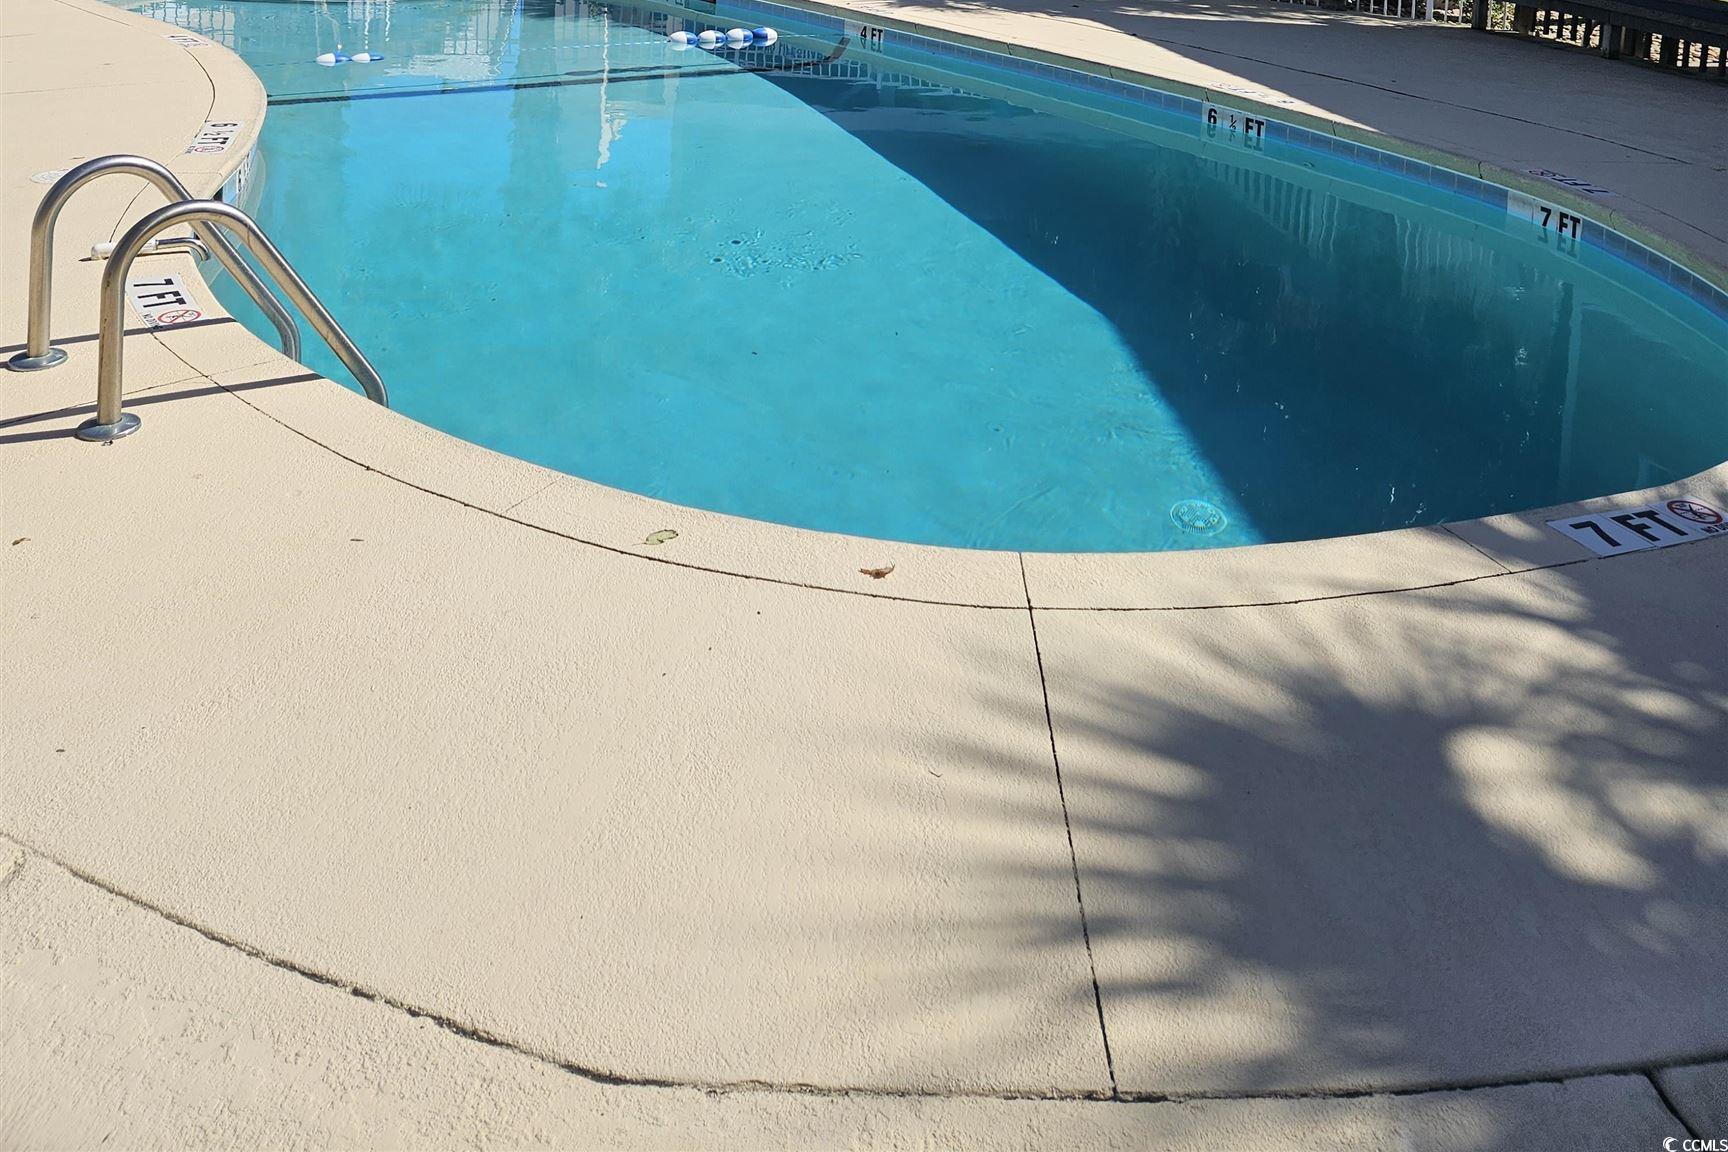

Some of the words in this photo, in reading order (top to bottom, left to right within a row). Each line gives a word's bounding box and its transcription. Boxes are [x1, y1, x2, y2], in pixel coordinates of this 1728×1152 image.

[861, 26, 867, 38] 4
[871, 28, 883, 41] FT
[1208, 108, 1218, 125] 6
[1245, 117, 1265, 138] FT
[1540, 206, 1552, 227] 7
[1558, 211, 1581, 239] FT
[133, 278, 175, 287] 7
[137, 290, 187, 308] FT
[1569, 520, 1622, 548] 7
[1610, 509, 1689, 542] FT
